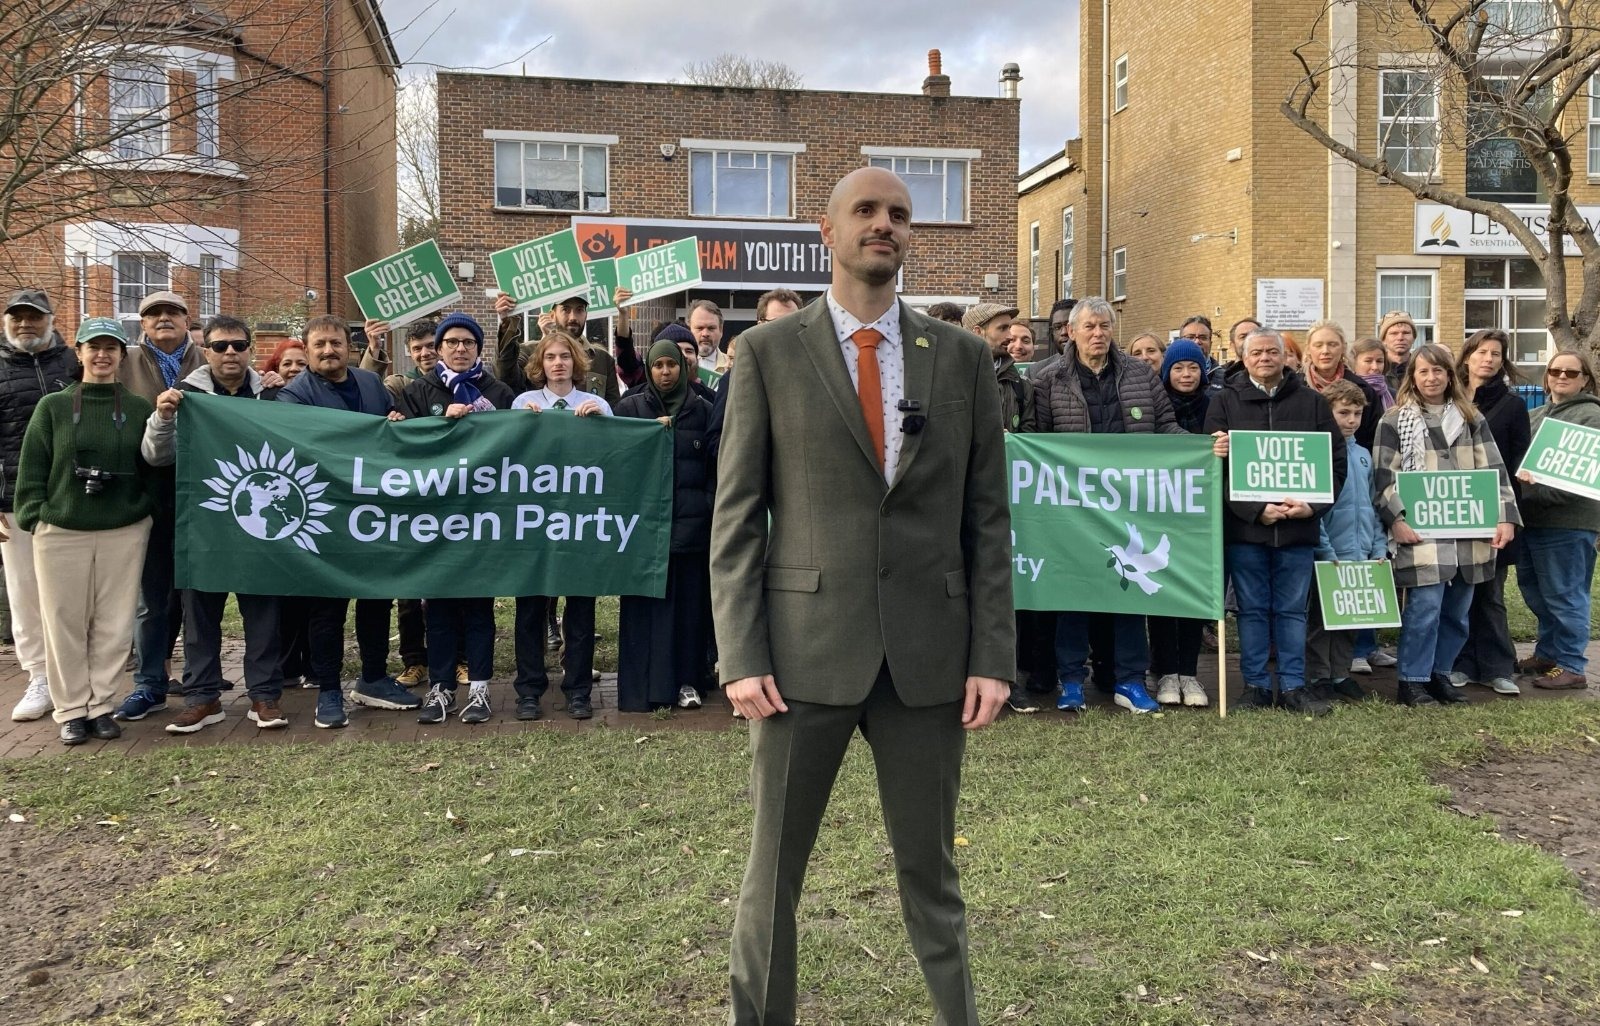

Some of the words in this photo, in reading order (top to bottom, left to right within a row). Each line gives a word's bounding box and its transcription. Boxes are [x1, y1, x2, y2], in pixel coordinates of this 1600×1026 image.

[1473, 156, 1531, 169] ADVENTIS
[370, 253, 422, 290] VOTE
[512, 240, 558, 272] VOTE
[637, 246, 677, 272] VOTE
[744, 241, 805, 272] YOUTH
[511, 260, 574, 300] GREEN
[631, 261, 688, 294] GREEN
[374, 271, 443, 318] GREEN
[1255, 436, 1305, 461] VOTE
[352, 456, 604, 497] Lewisham
[1246, 461, 1316, 489] GREEN
[1536, 446, 1600, 485] GREEN
[1012, 459, 1206, 513] PALESTINE
[1422, 475, 1473, 499] VOTE
[348, 504, 501, 543] Green
[515, 504, 640, 552] Party
[1414, 499, 1485, 526] GREEN
[1336, 564, 1375, 588] VOTE
[1332, 588, 1387, 616] GREEN
